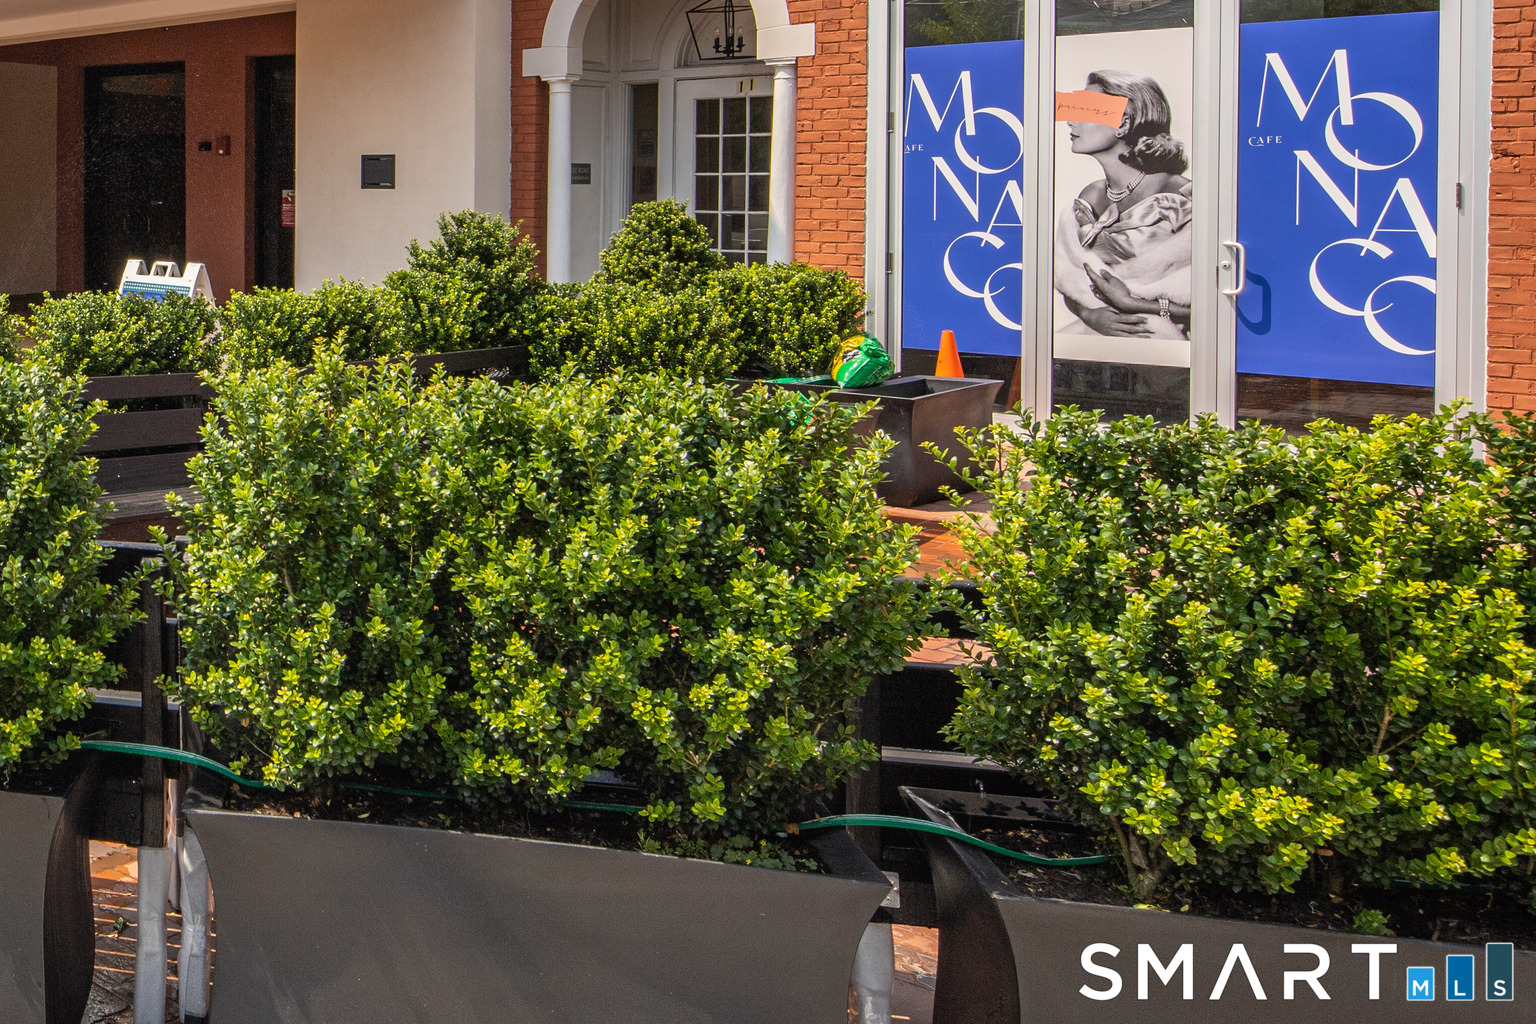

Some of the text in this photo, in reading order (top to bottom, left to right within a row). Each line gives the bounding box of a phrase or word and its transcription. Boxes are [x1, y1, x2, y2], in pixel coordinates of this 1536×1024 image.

[739, 79, 754, 93] 11
[1248, 135, 1282, 147] CAFE
[904, 144, 924, 154] AFE
